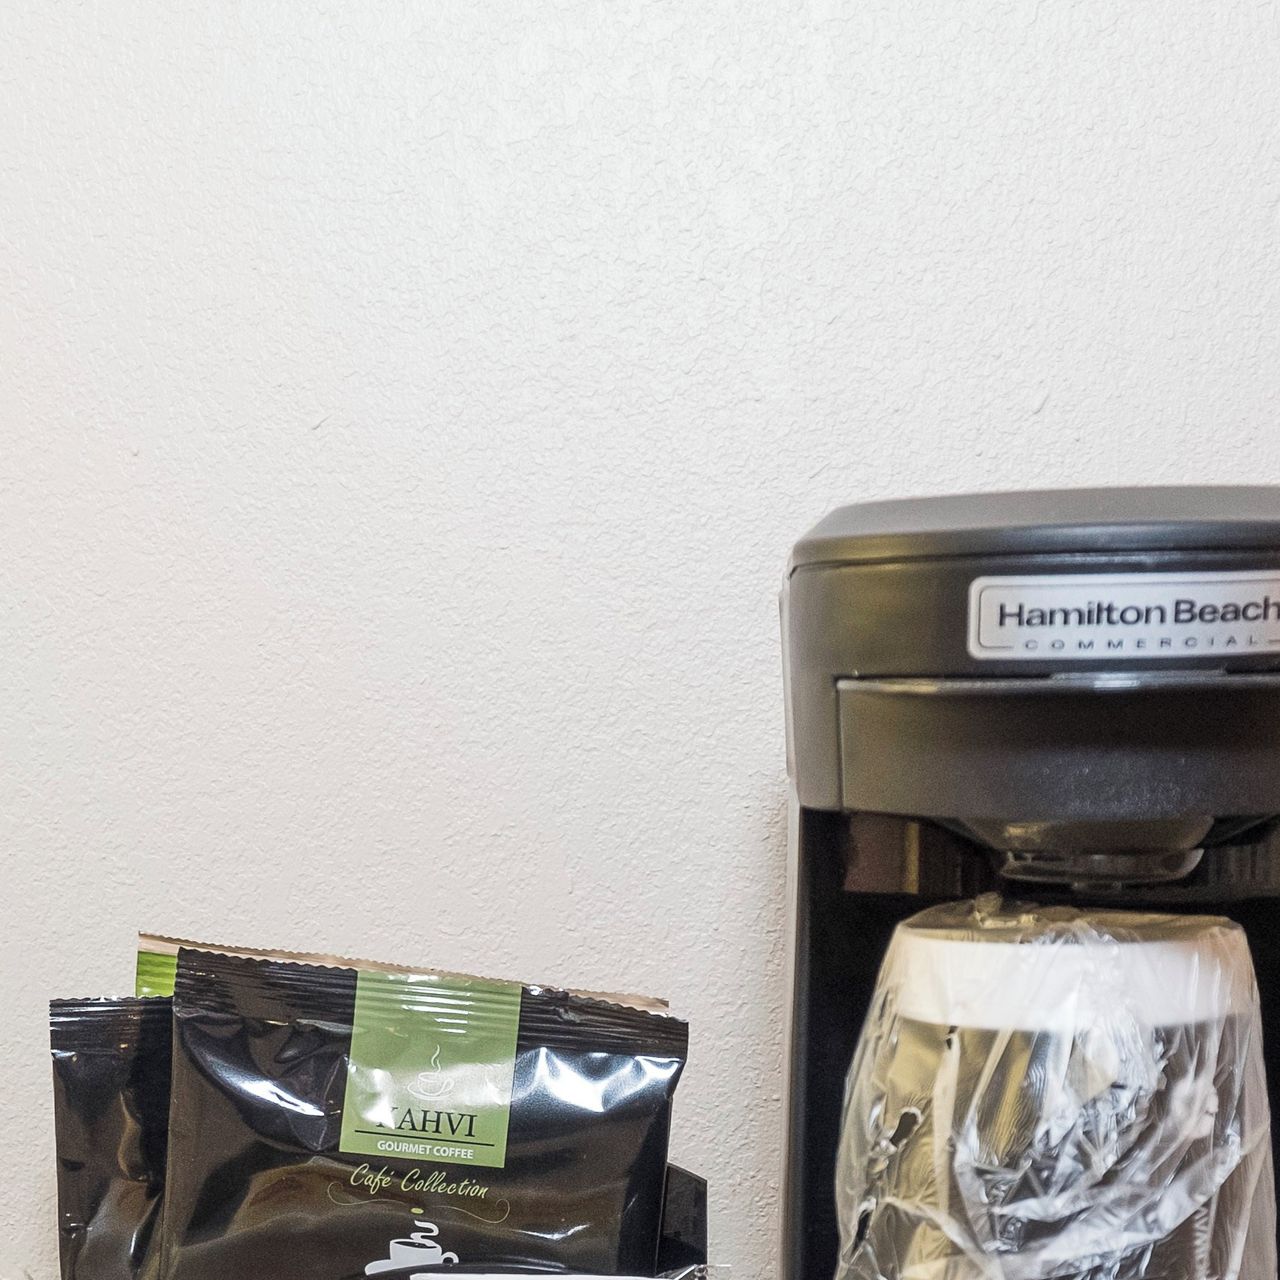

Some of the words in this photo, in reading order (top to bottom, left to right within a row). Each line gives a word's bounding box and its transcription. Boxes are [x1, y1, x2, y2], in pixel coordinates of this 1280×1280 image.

[999, 601, 1166, 626] Hamilton
[1024, 635, 1260, 651] COMMERCIAL
[376, 1106, 478, 1138] AHVI
[377, 1140, 432, 1156] GOURMET
[433, 1145, 474, 1159] COFFEE
[350, 1163, 394, 1194] Café
[400, 1168, 490, 1200] Collection
